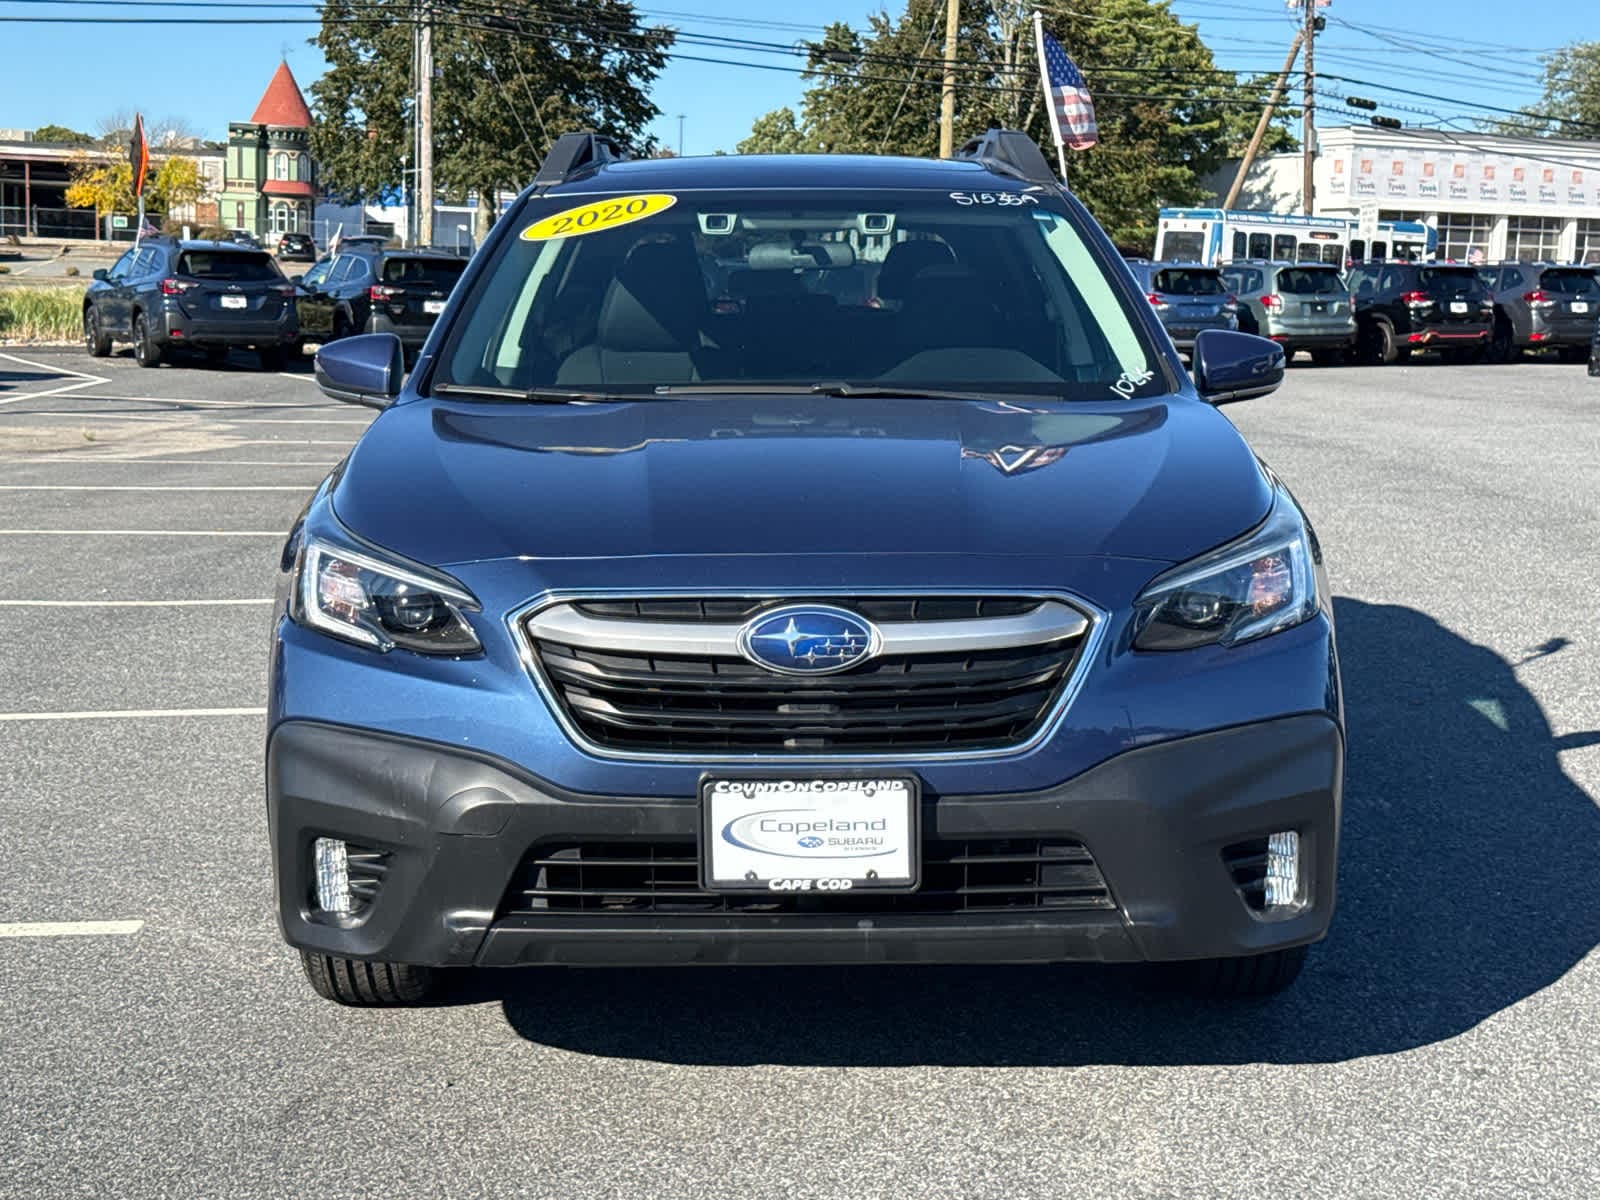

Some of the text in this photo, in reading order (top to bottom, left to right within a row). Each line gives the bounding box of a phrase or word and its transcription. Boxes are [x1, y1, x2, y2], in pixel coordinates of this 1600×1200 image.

[551, 198, 649, 235] 2020
[760, 818, 886, 835] Copeland
[828, 837, 883, 846] SUBARU
